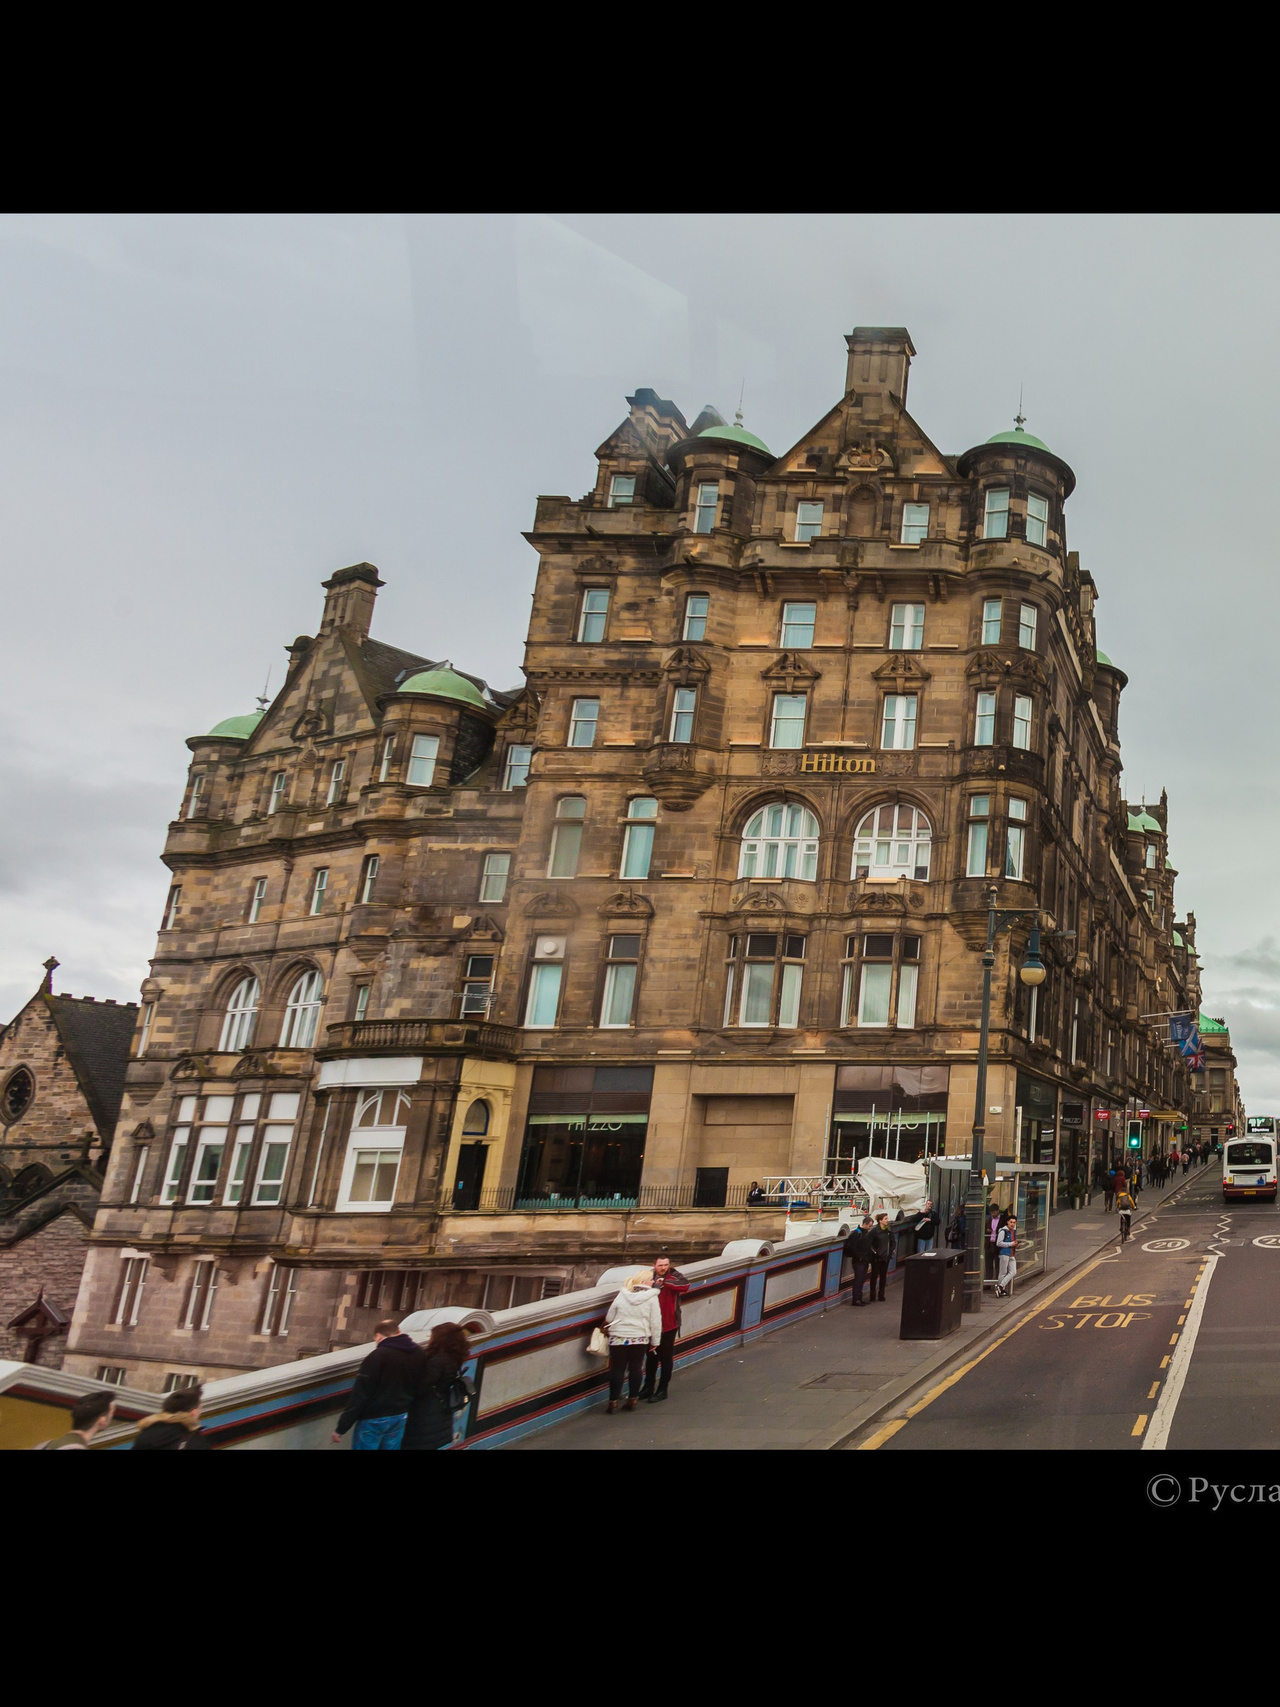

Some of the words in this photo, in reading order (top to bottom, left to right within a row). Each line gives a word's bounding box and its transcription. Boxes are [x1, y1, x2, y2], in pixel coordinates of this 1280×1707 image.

[800, 753, 876, 773] Hilton
[1153, 1239, 1182, 1249] 20
[1068, 1293, 1156, 1309] BUS
[1038, 1312, 1153, 1330] STOP
